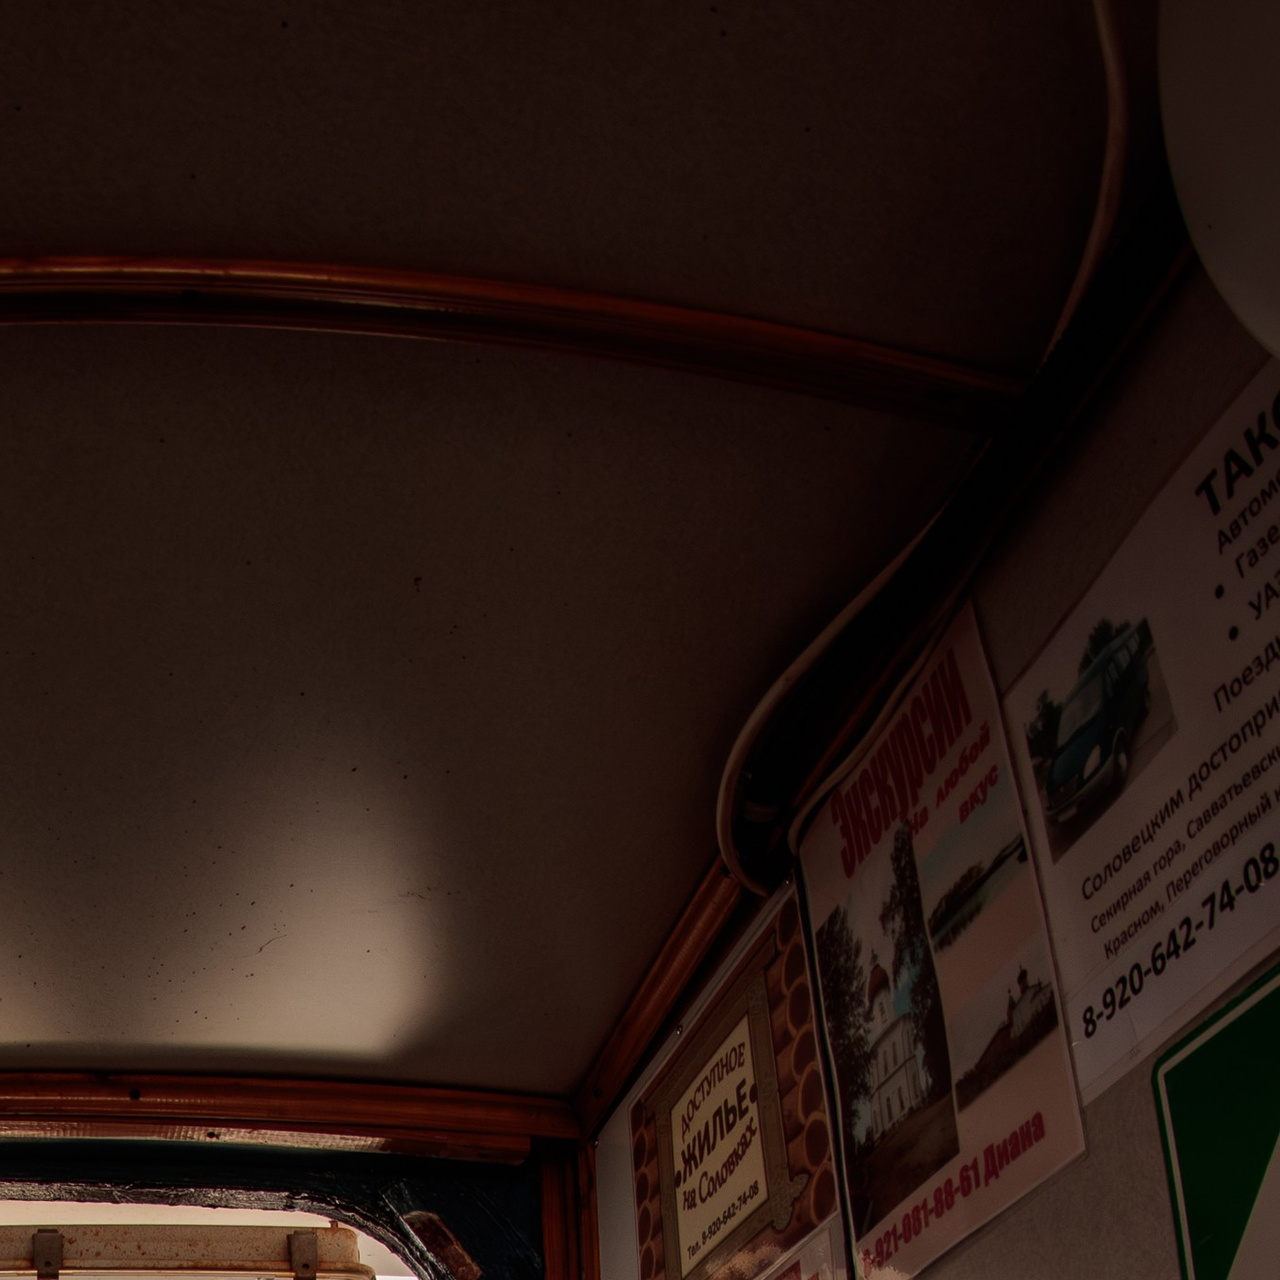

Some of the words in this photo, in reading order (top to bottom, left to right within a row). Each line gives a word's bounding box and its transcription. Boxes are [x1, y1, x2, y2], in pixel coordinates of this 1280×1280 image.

[1218, 469, 1280, 554] Автом
[1081, 789, 1185, 900] Соловецким
[1187, 687, 1280, 802] достопри
[1090, 872, 1152, 934] Секирная
[1153, 838, 1186, 884] гора,
[1103, 895, 1165, 961] Красном,
[1166, 791, 1272, 904] Переговорный
[1082, 842, 1280, 1039] 8-920-642-74-08
[681, 1042, 746, 1143] ДОСТУПНОЕ
[983, 1111, 1046, 1187] Диана
[702, 1181, 759, 1245] 8-920-642-74-08
